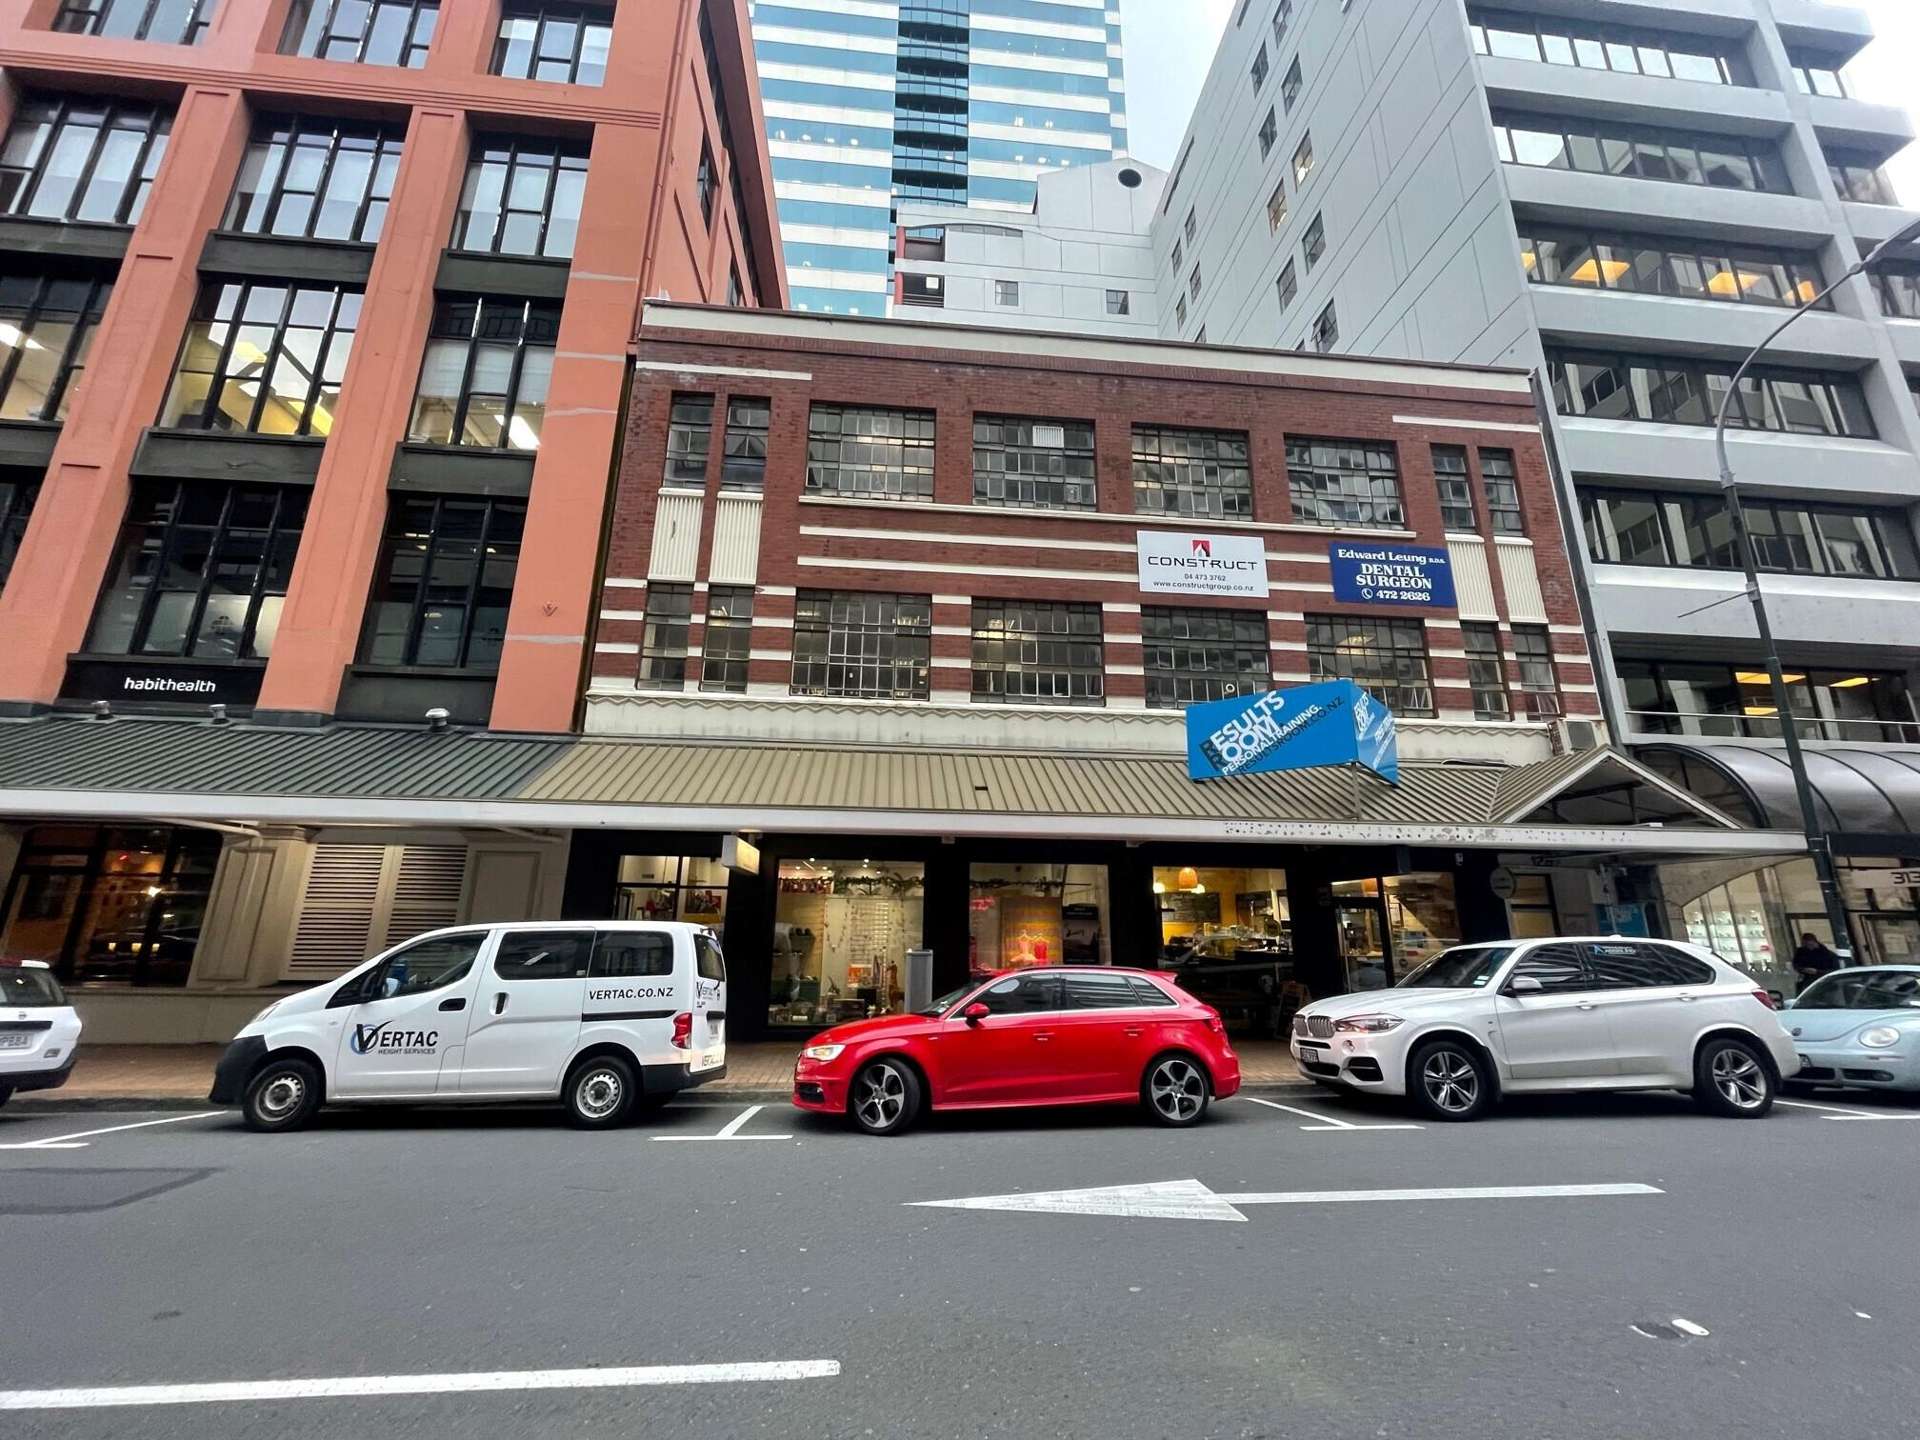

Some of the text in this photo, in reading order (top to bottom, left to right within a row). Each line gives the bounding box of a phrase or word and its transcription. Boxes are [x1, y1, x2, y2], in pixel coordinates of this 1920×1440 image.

[1147, 556, 1258, 570] CONSTRUCT
[1337, 549, 1386, 561] Edward
[1388, 552, 1427, 565] Leung
[1361, 563, 1425, 578] DENTAL
[1153, 581, 1255, 592] www.constructgroup.co.nz
[1356, 574, 1433, 589] SURGEON
[1376, 589, 1431, 602] 472 2626
[124, 677, 217, 693] habithealth
[589, 987, 674, 1001] VERTAC.CO.NZ
[356, 1019, 439, 1053] VERTAC
